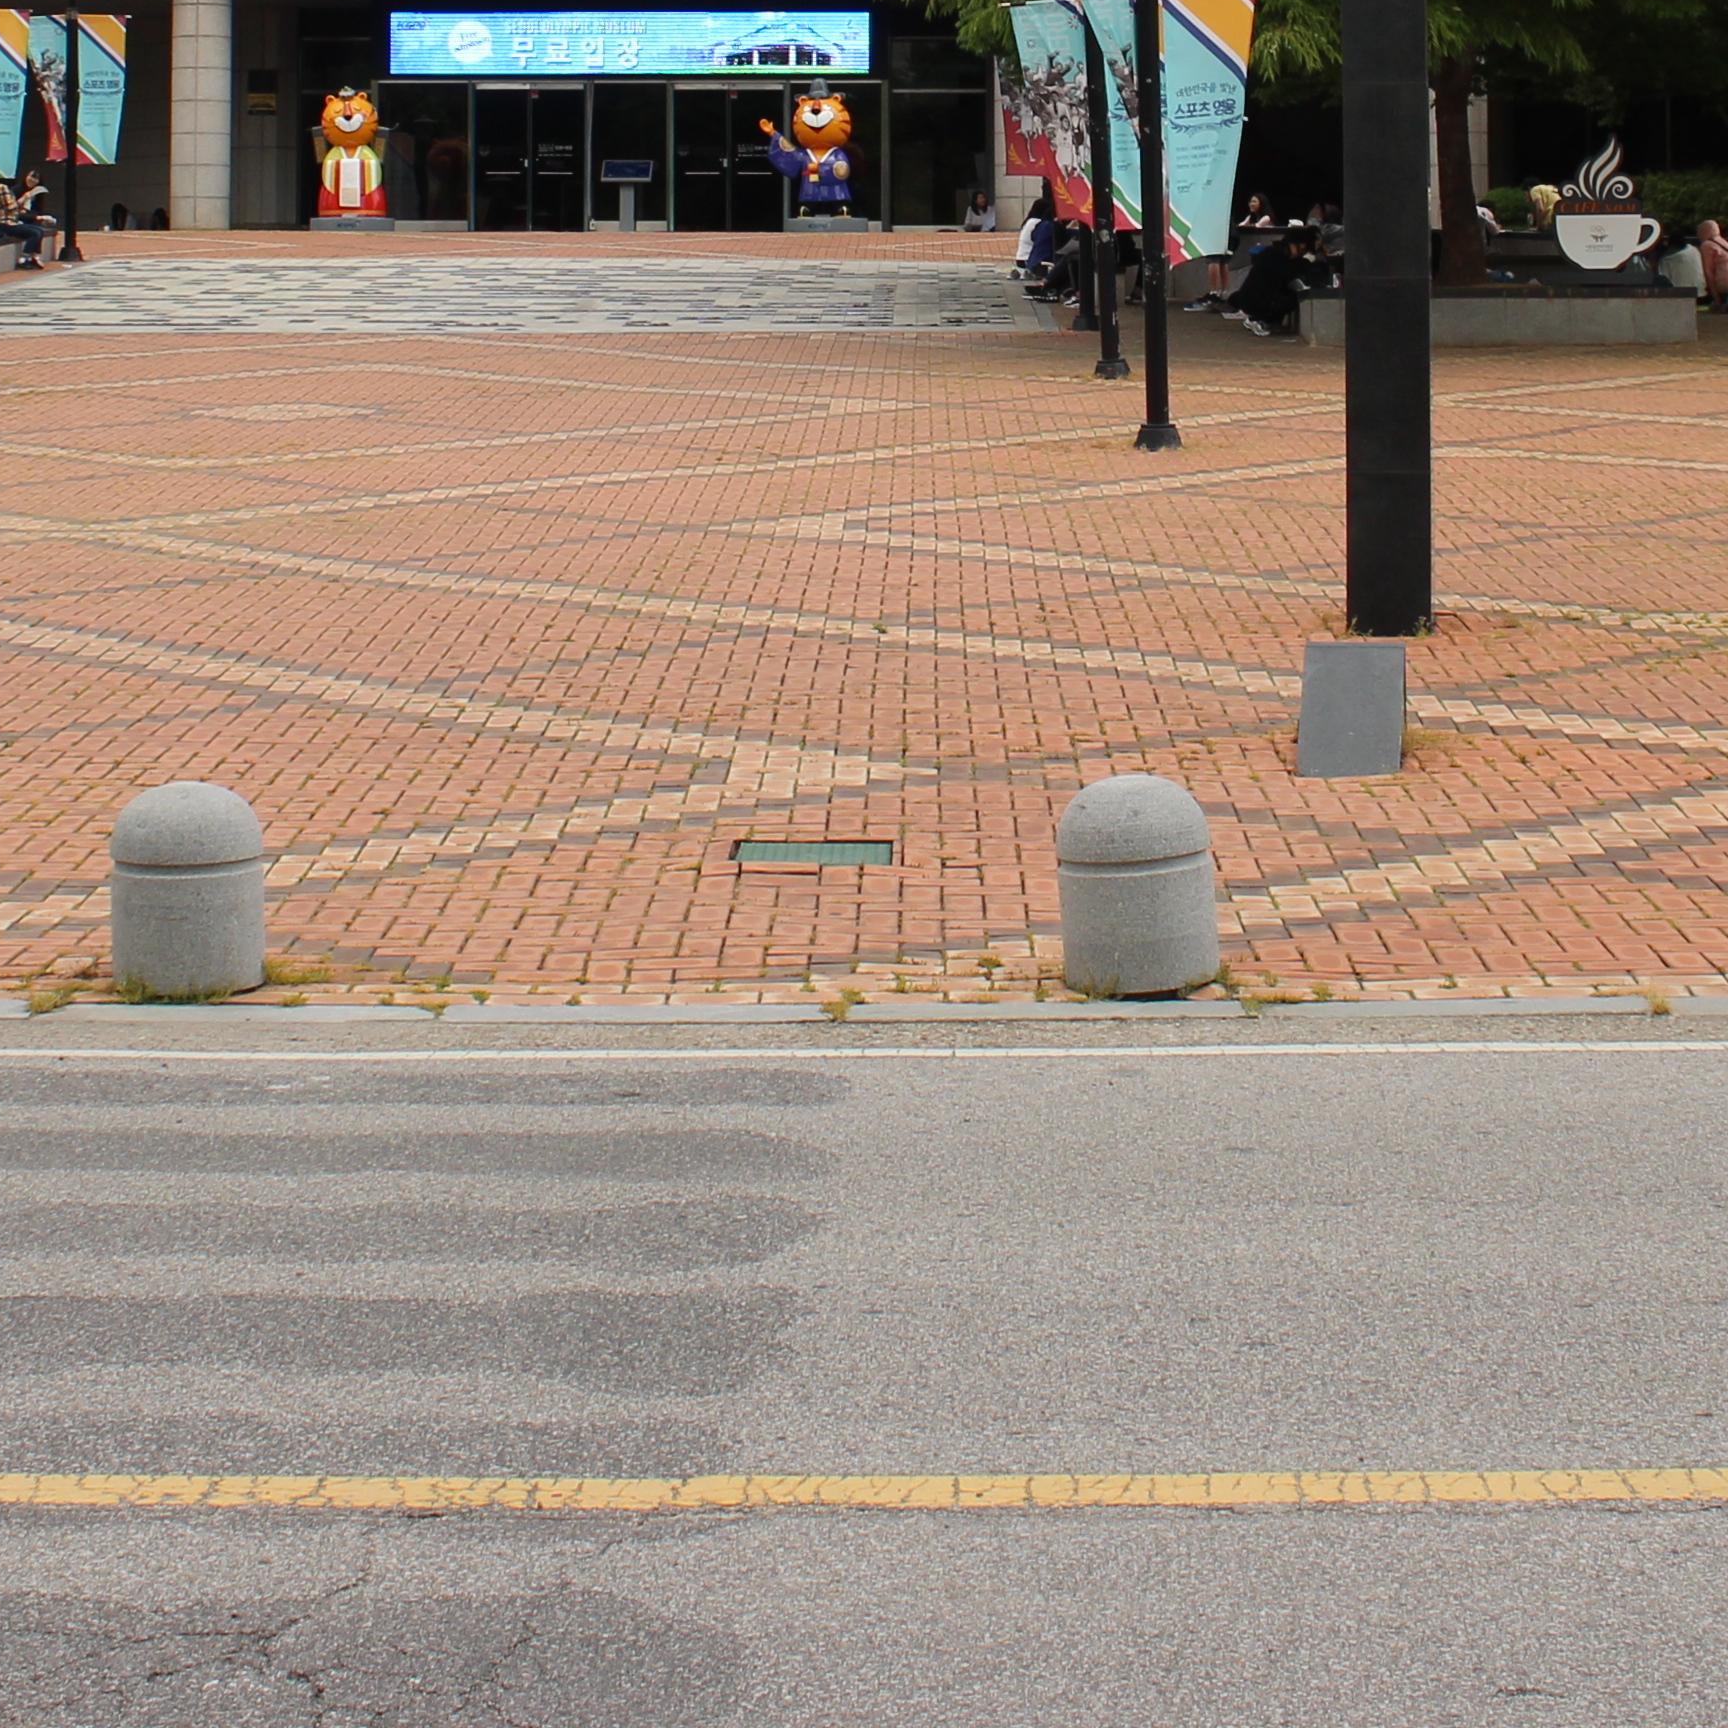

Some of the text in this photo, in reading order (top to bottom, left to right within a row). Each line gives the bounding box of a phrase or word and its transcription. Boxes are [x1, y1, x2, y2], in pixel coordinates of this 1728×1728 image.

[511, 37, 642, 70] 무료입장
[1174, 98, 1238, 120] 스포츠 영웅
